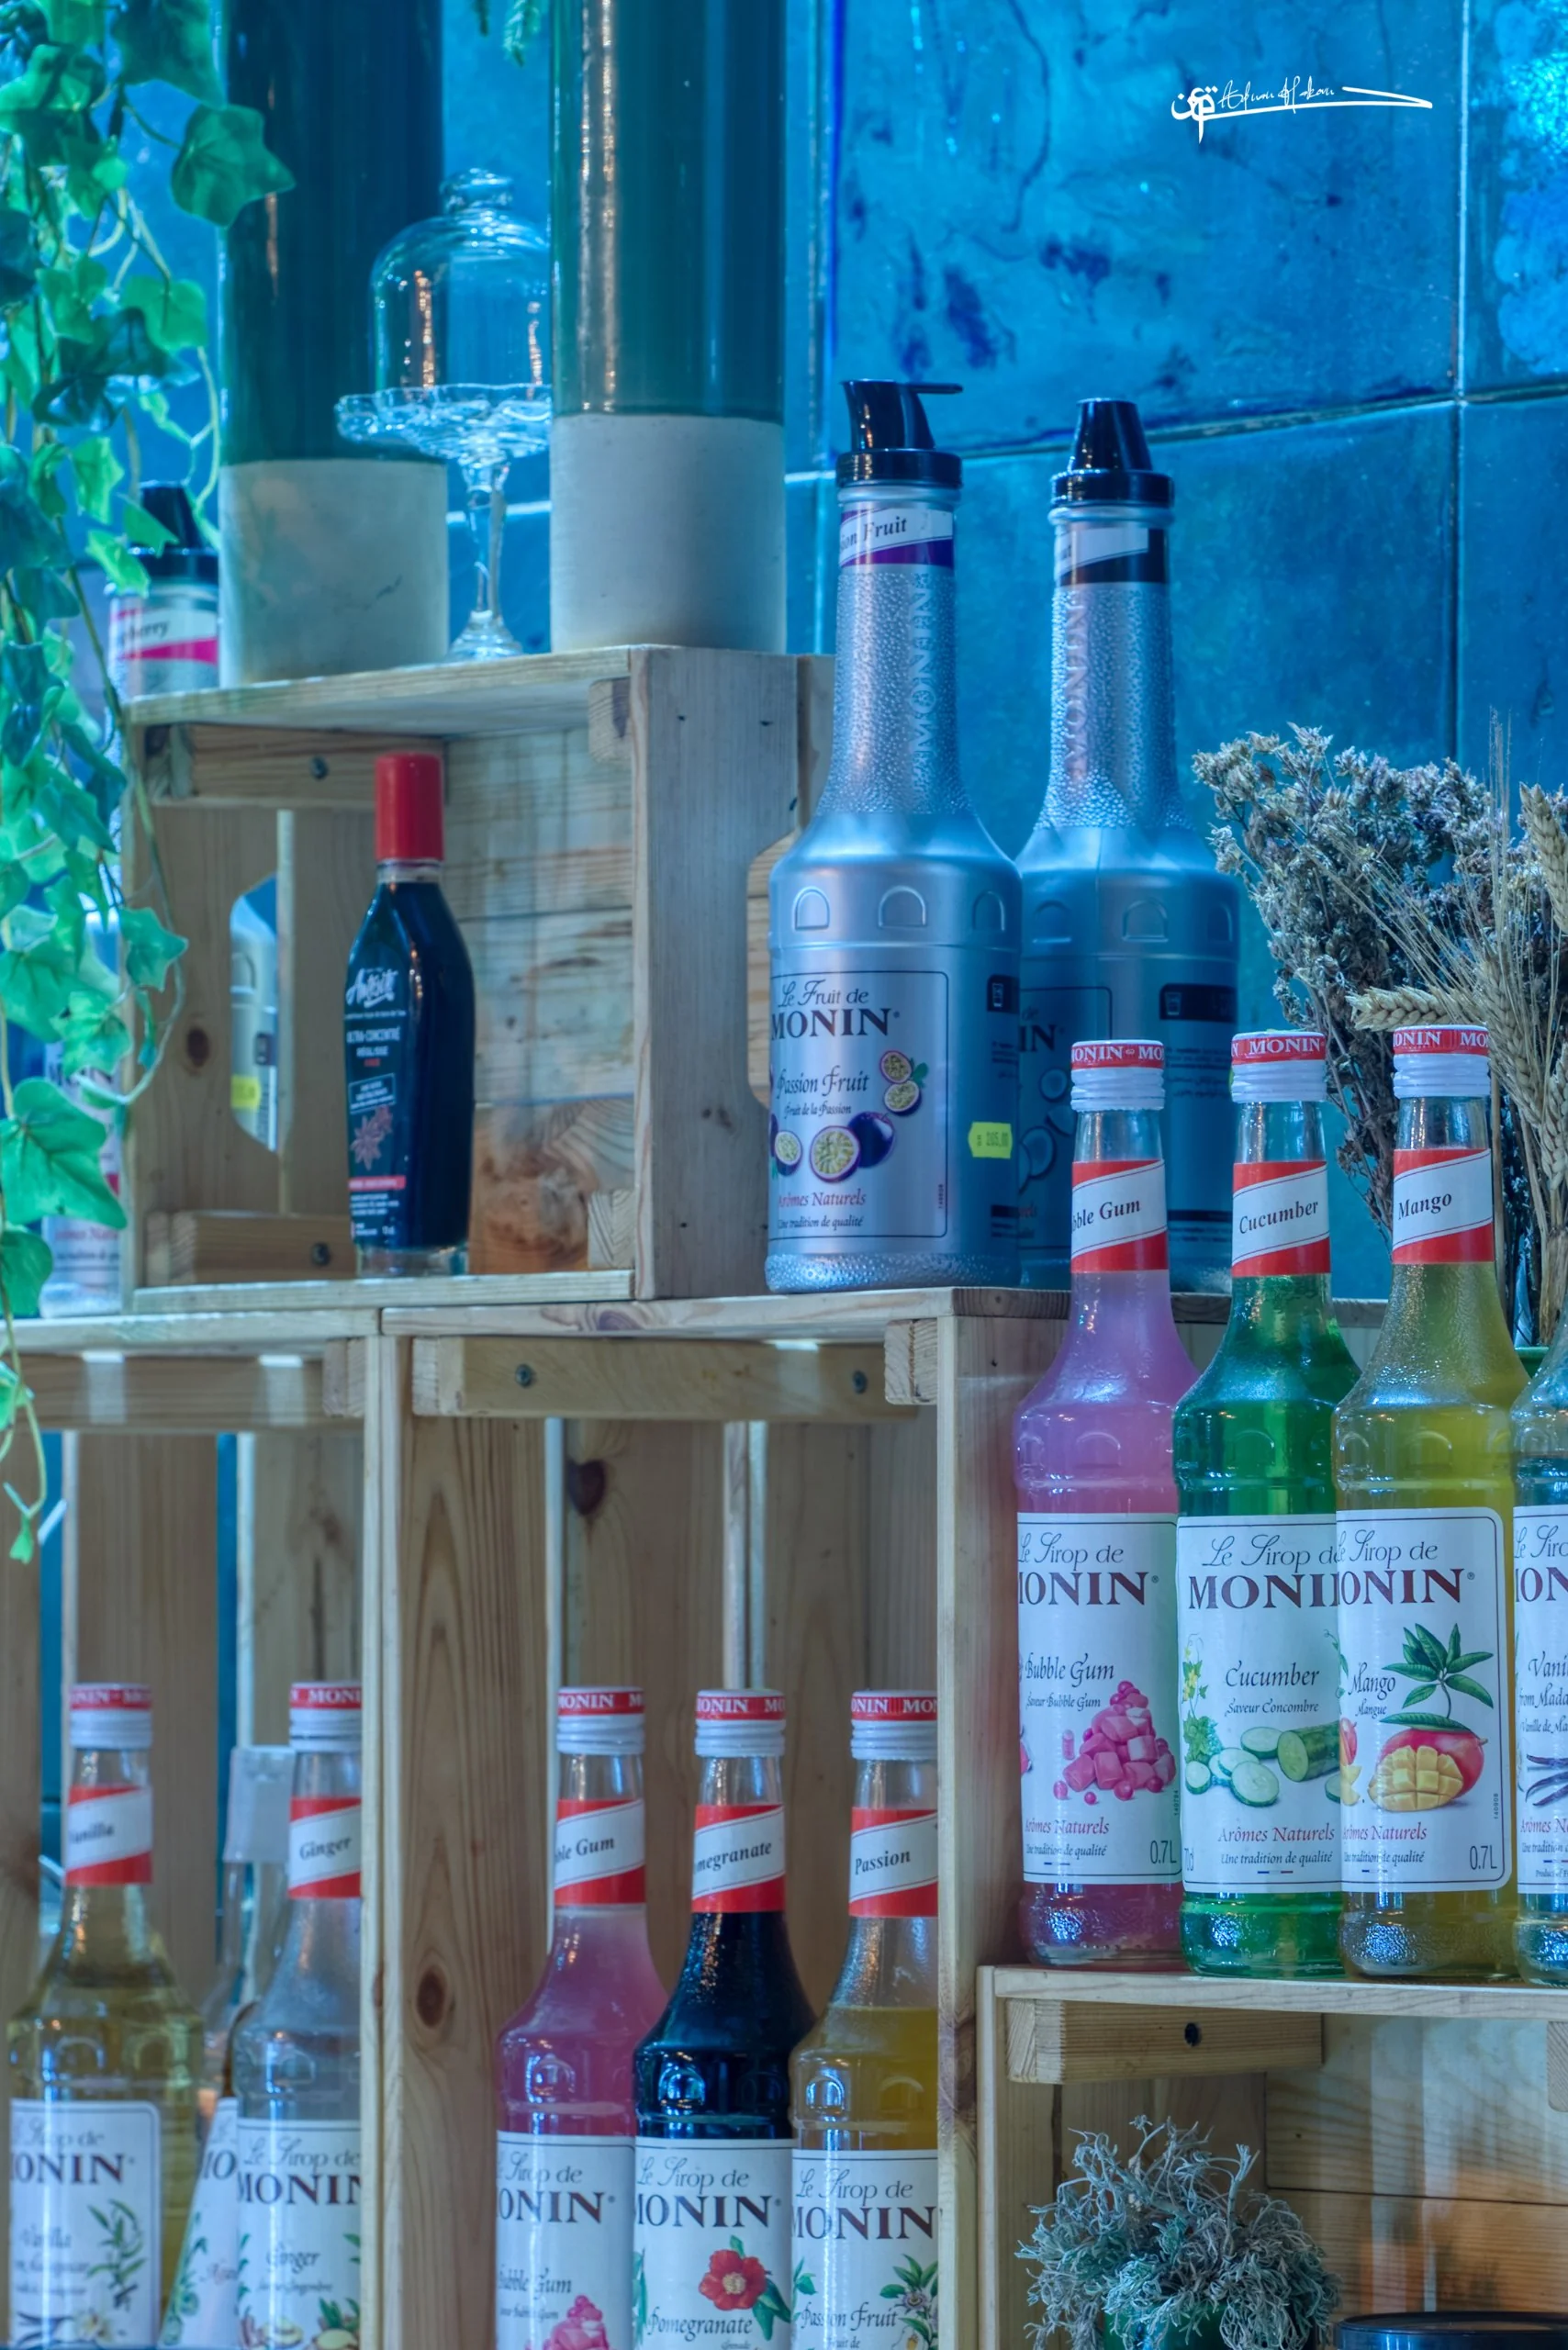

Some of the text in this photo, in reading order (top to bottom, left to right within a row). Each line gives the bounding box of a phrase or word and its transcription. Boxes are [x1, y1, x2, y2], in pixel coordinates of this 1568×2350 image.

[863, 516, 908, 542] Fruit
[778, 979, 869, 1008] Le Fruit de
[1249, 1037, 1321, 1056] MONIN
[776, 1064, 870, 1100] Passion Fruit
[812, 1188, 867, 1207] Naturels
[1099, 1200, 1141, 1220] Gum
[1397, 1192, 1453, 1221] Mango
[832, 1214, 865, 1231] qualité
[1239, 1199, 1318, 1235] Cucumber
[1034, 1531, 1089, 1571] Sirop
[1095, 1545, 1125, 1563] de
[1201, 1535, 1236, 1567] Le
[1240, 1534, 1311, 1572] Sirop
[1349, 1528, 1402, 1569] Sirop
[1409, 1541, 1439, 1561] de
[1338, 1568, 1465, 1605] ONIN
[1025, 1652, 1115, 1687] Bubble Gum
[1226, 1660, 1320, 1688] Cucumber
[1348, 1661, 1396, 1700] Mango
[1047, 1693, 1076, 1708] Bubble
[1076, 1693, 1102, 1712] Gum
[1225, 1697, 1320, 1717] Saveur Concombre
[1354, 1698, 1388, 1720] Mangue
[1054, 1816, 1110, 1835] Naturels
[1217, 1822, 1336, 1843] Arômes Naturels
[1371, 1820, 1428, 1841] Naturels
[299, 1837, 352, 1861] Ginger
[576, 1837, 615, 1857] Gum
[1074, 1843, 1107, 1860] qualité
[1149, 1840, 1178, 1864] 0.7L
[1220, 1851, 1334, 1868] Une tradition de qualité
[1391, 1849, 1425, 1867] qualité
[1469, 1844, 1498, 1871] 0.7L
[855, 1850, 911, 1874] Passion
[556, 2165, 583, 2184] de
[656, 2156, 715, 2196] Sirop
[722, 2169, 750, 2188] de
[795, 2167, 913, 2207] Le Sirop de
[498, 2188, 606, 2224] ONIN
[646, 2306, 754, 2343] Pomegranate
[800, 2300, 900, 2332] Passon Fruit
